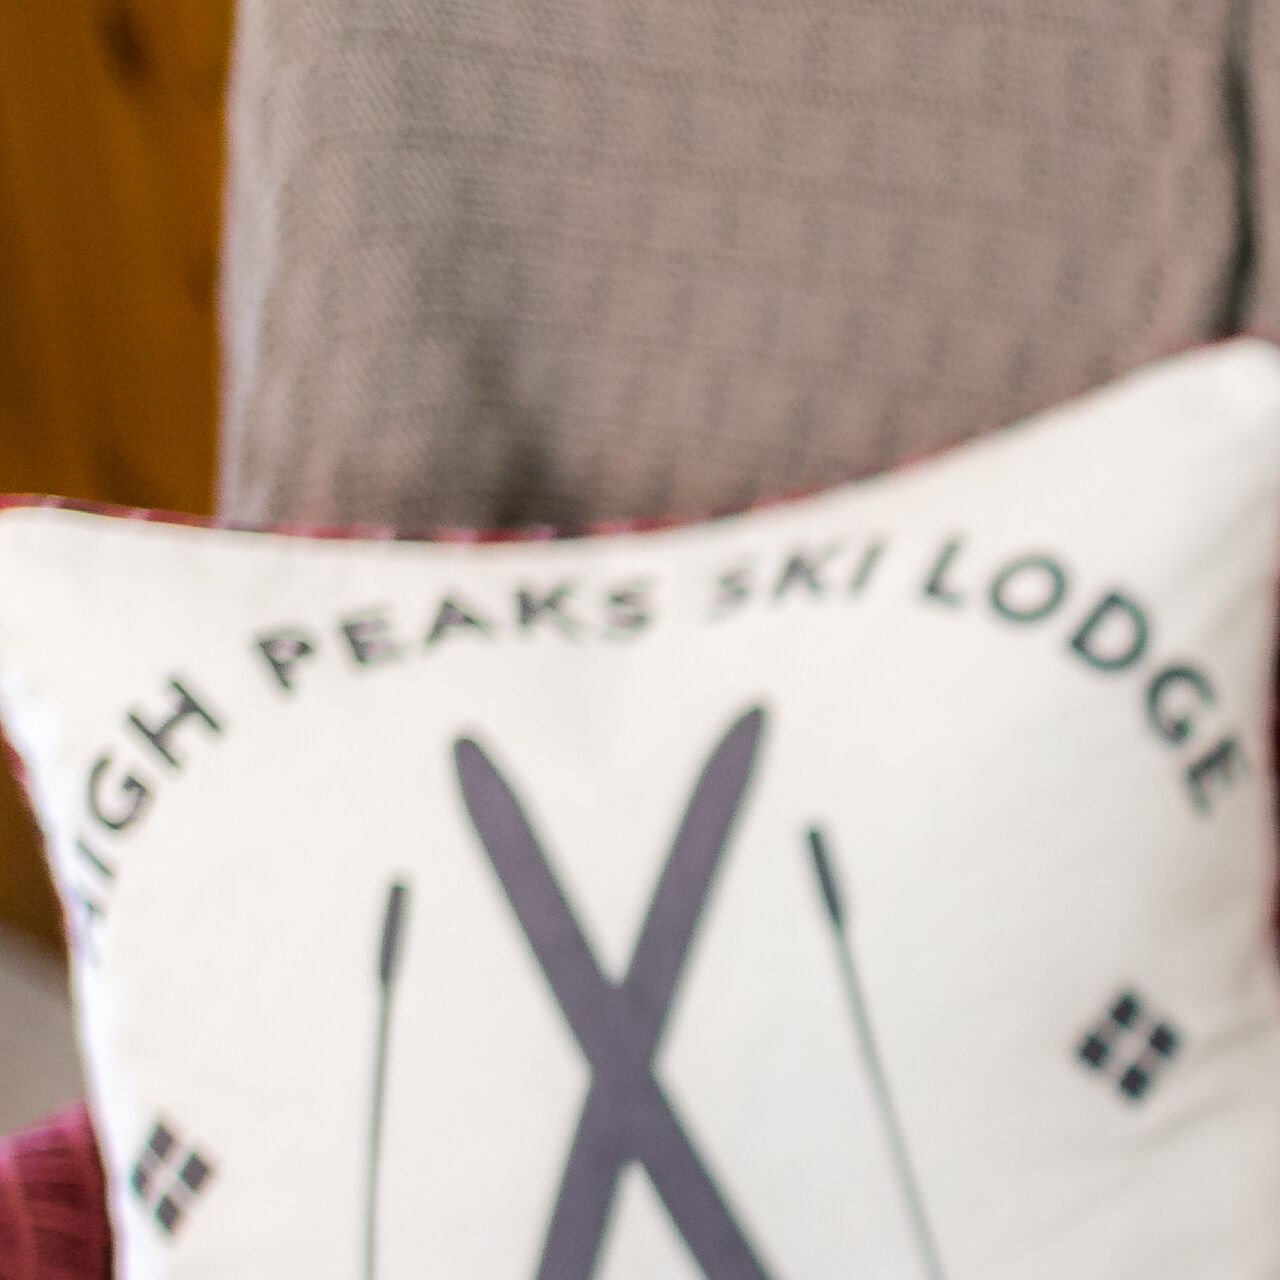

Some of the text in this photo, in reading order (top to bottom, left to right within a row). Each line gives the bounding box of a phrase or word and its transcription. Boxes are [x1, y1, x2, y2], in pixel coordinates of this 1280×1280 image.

[255, 577, 655, 690] PEAKS
[707, 537, 887, 622] SKI
[920, 533, 1248, 813] LODGE
